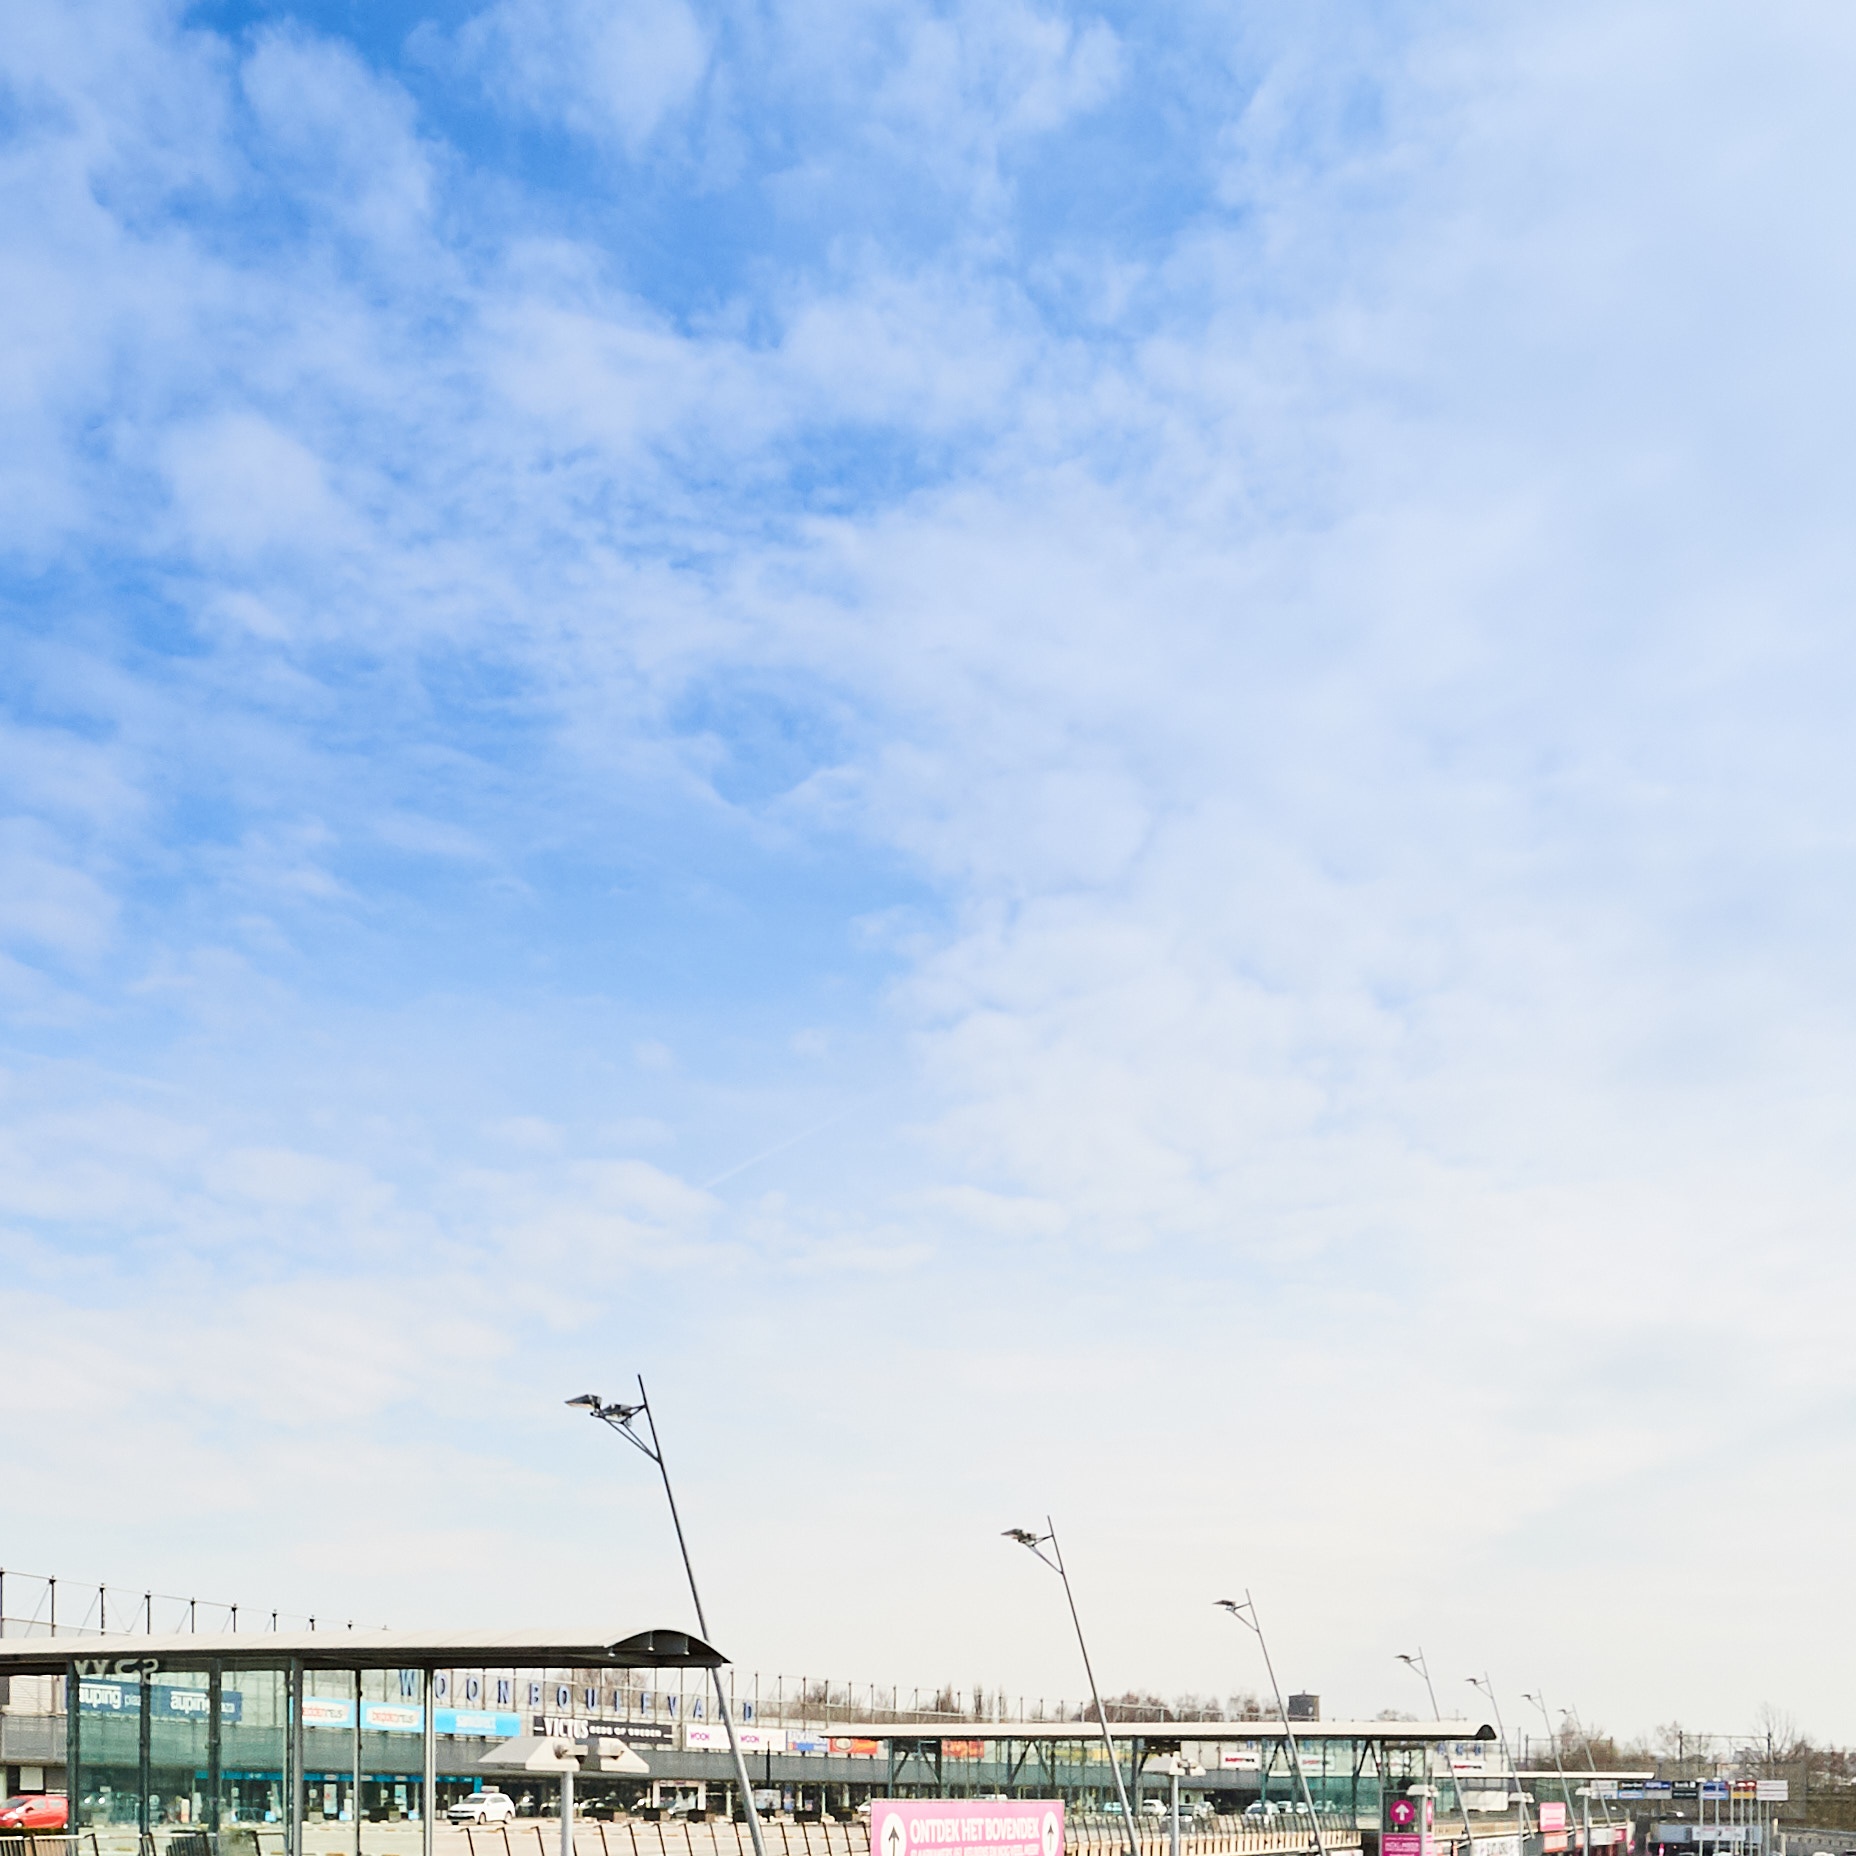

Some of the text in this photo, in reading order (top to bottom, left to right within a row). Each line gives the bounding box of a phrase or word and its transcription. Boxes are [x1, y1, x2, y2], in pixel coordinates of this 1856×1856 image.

[544, 1717, 589, 1739] VICTUS
[910, 1817, 1040, 1844] ONTDEK HET BOVENDEK
